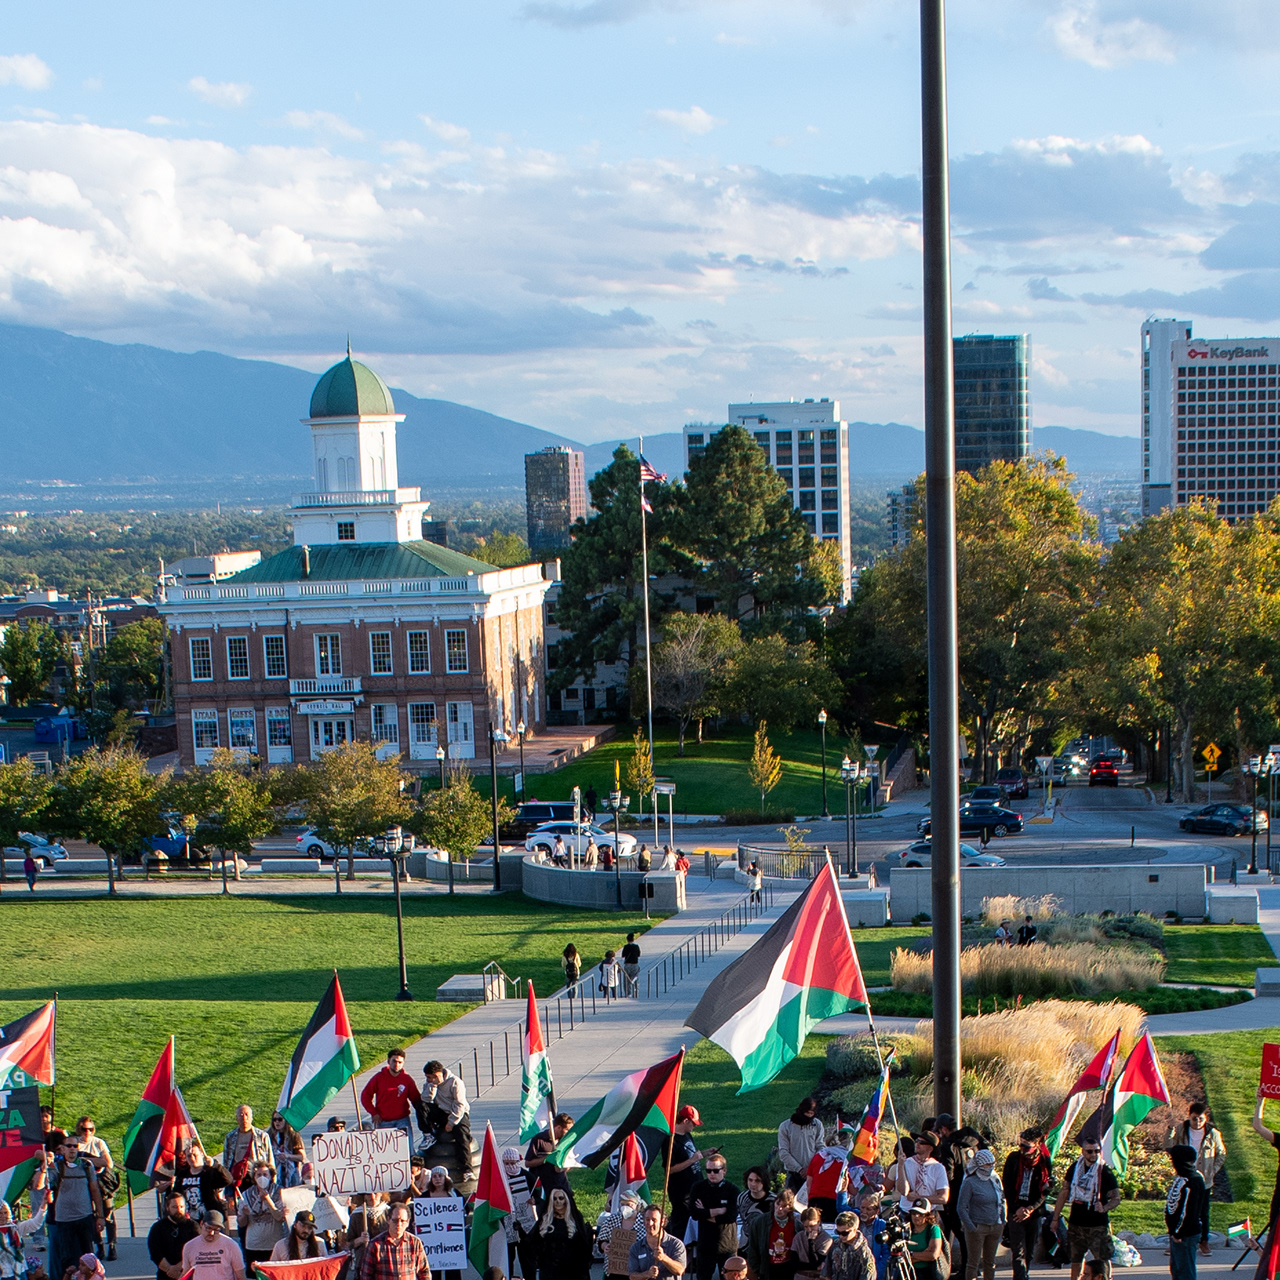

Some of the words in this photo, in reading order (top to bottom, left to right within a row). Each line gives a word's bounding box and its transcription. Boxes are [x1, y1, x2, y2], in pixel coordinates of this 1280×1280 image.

[1210, 346, 1269, 361] KeyBank
[316, 1134, 364, 1162] DONALD
[360, 1128, 405, 1155] TRUMP
[346, 1155, 362, 1167] IS
[367, 1153, 375, 1165] A
[317, 1166, 358, 1196] NAZI
[362, 1159, 409, 1192] RAPIST
[415, 1202, 459, 1217] Scilence
[434, 1222, 444, 1232] IS
[615, 1230, 636, 1240] ONE
